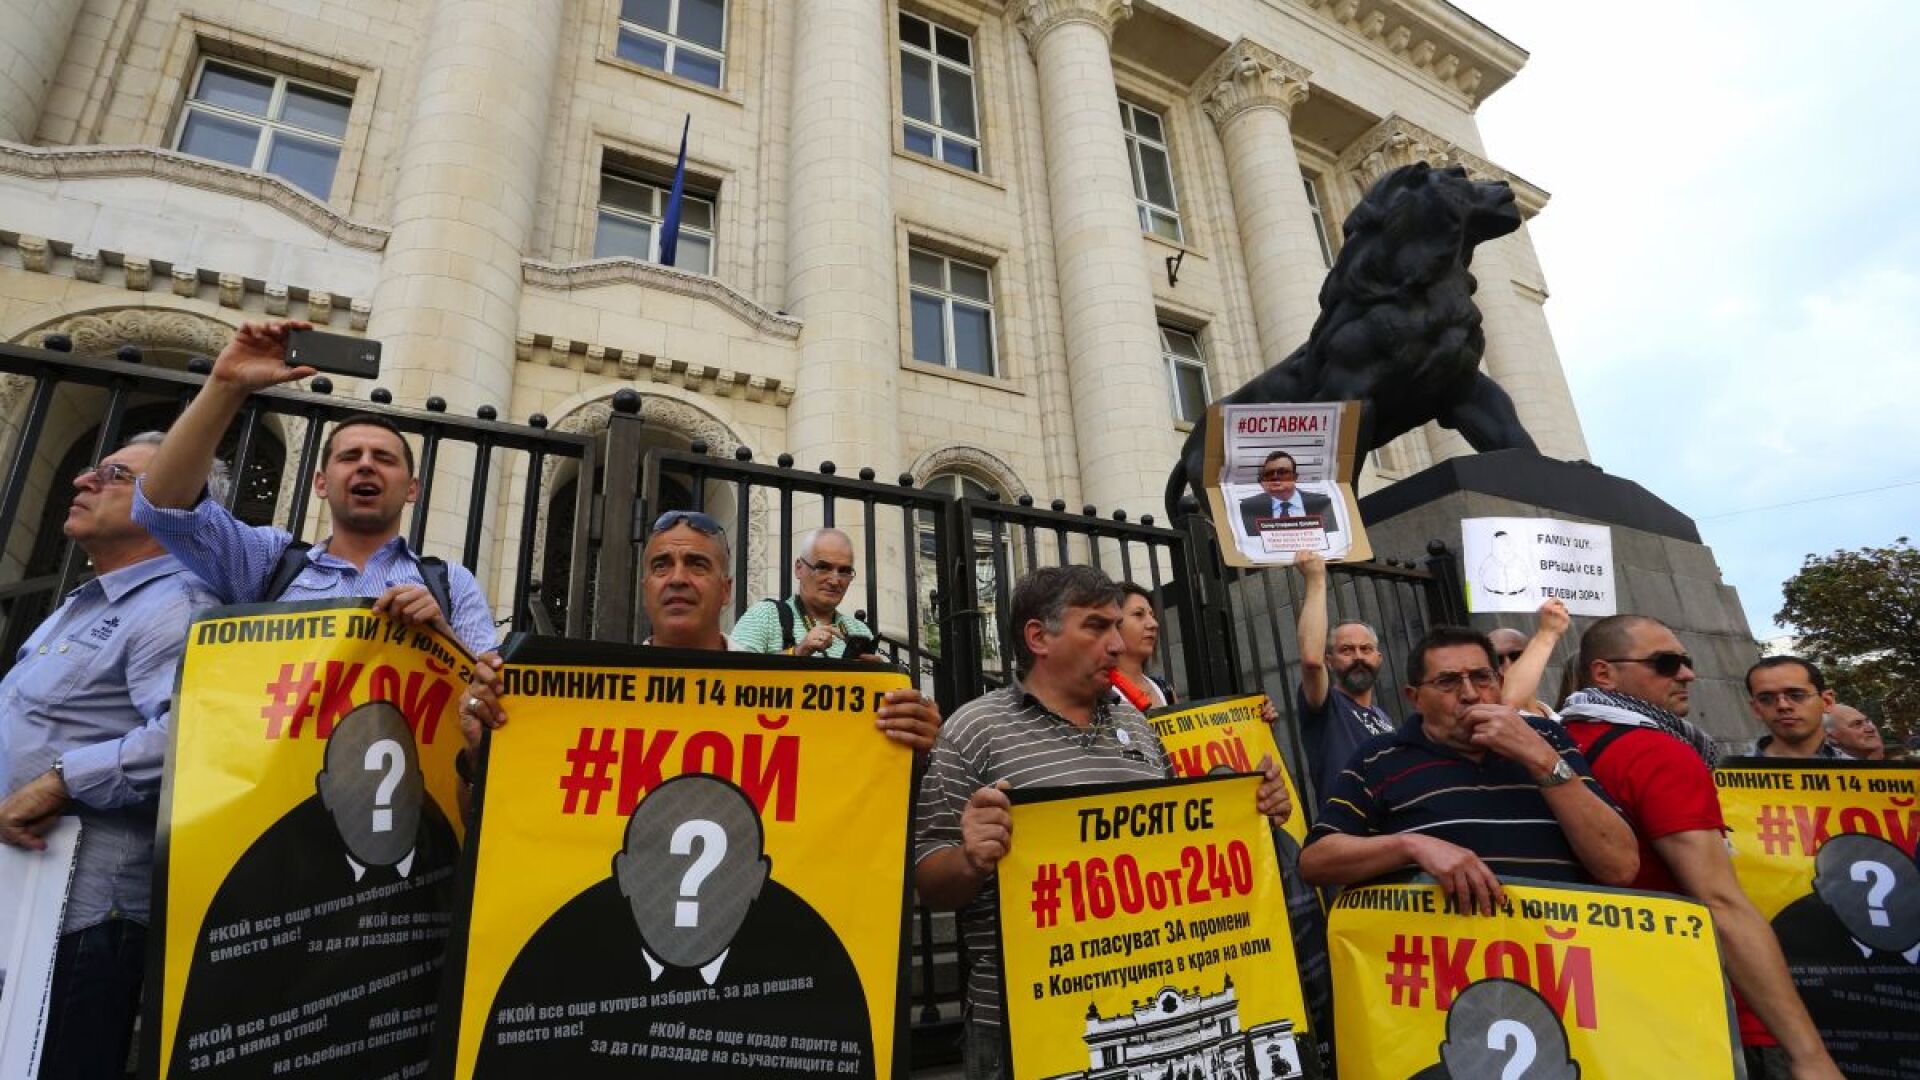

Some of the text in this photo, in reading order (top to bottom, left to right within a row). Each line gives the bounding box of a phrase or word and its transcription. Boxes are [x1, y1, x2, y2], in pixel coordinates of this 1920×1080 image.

[1238, 415, 1318, 433] #ОСТАВКА
[1536, 533, 1571, 548] FAMILY
[197, 616, 336, 645] ПОМНИТЕ
[345, 616, 378, 640] ЛИ
[384, 622, 406, 645] 14
[503, 668, 636, 702] ПОМНИТЕ
[645, 676, 685, 703] ЛИ
[695, 678, 726, 707] 14
[801, 683, 864, 713] 2013
[364, 738, 406, 833] ?
[559, 714, 800, 822] #КОЙ
[1715, 771, 1795, 790] ОМНИТЕ
[1800, 774, 1831, 791] ЛИ
[1837, 775, 1861, 792] 14
[1078, 798, 1214, 843] ТЪРСЯТ СЕ
[670, 818, 728, 929] ?
[1031, 839, 1253, 929] #160от240
[1850, 860, 1896, 927] ?
[208, 919, 250, 944] #КОЙ
[255, 916, 281, 933] все
[285, 906, 311, 925] още
[314, 894, 354, 917] купува
[358, 911, 388, 929] #КОЙ
[1337, 889, 1435, 914] ПОМНИТЕ
[1587, 903, 1655, 932] 2013
[1664, 914, 1703, 939] г.?
[210, 927, 301, 962] вместо нас!
[308, 939, 322, 952] за
[326, 936, 342, 951] да
[343, 935, 359, 948] ги
[361, 930, 409, 948] раздаде
[1049, 911, 1250, 968] да гласуват ЗА промени
[1033, 937, 1271, 1000] в Конституцията в края на юли
[187, 1024, 233, 1050] #КОЙ
[237, 1018, 265, 1036] все
[269, 1007, 299, 1027] още
[302, 985, 366, 1016] прокужда
[368, 1006, 400, 1030] #КОЙ
[498, 976, 814, 1024] #КОЙ все още купува изборите, за да решава
[189, 1014, 328, 1071] за да няма отпор!
[498, 1022, 584, 1046] вместо нас!
[590, 1038, 860, 1075] за да ги раздаде на съучастниците си!
[649, 1020, 686, 1039] #КОЙ
[688, 1026, 714, 1042] все
[716, 1028, 744, 1046] още
[747, 1031, 787, 1050] краде
[790, 1034, 838, 1054] парите
[273, 1060, 291, 1075] на
[295, 1039, 365, 1069] съдебната
